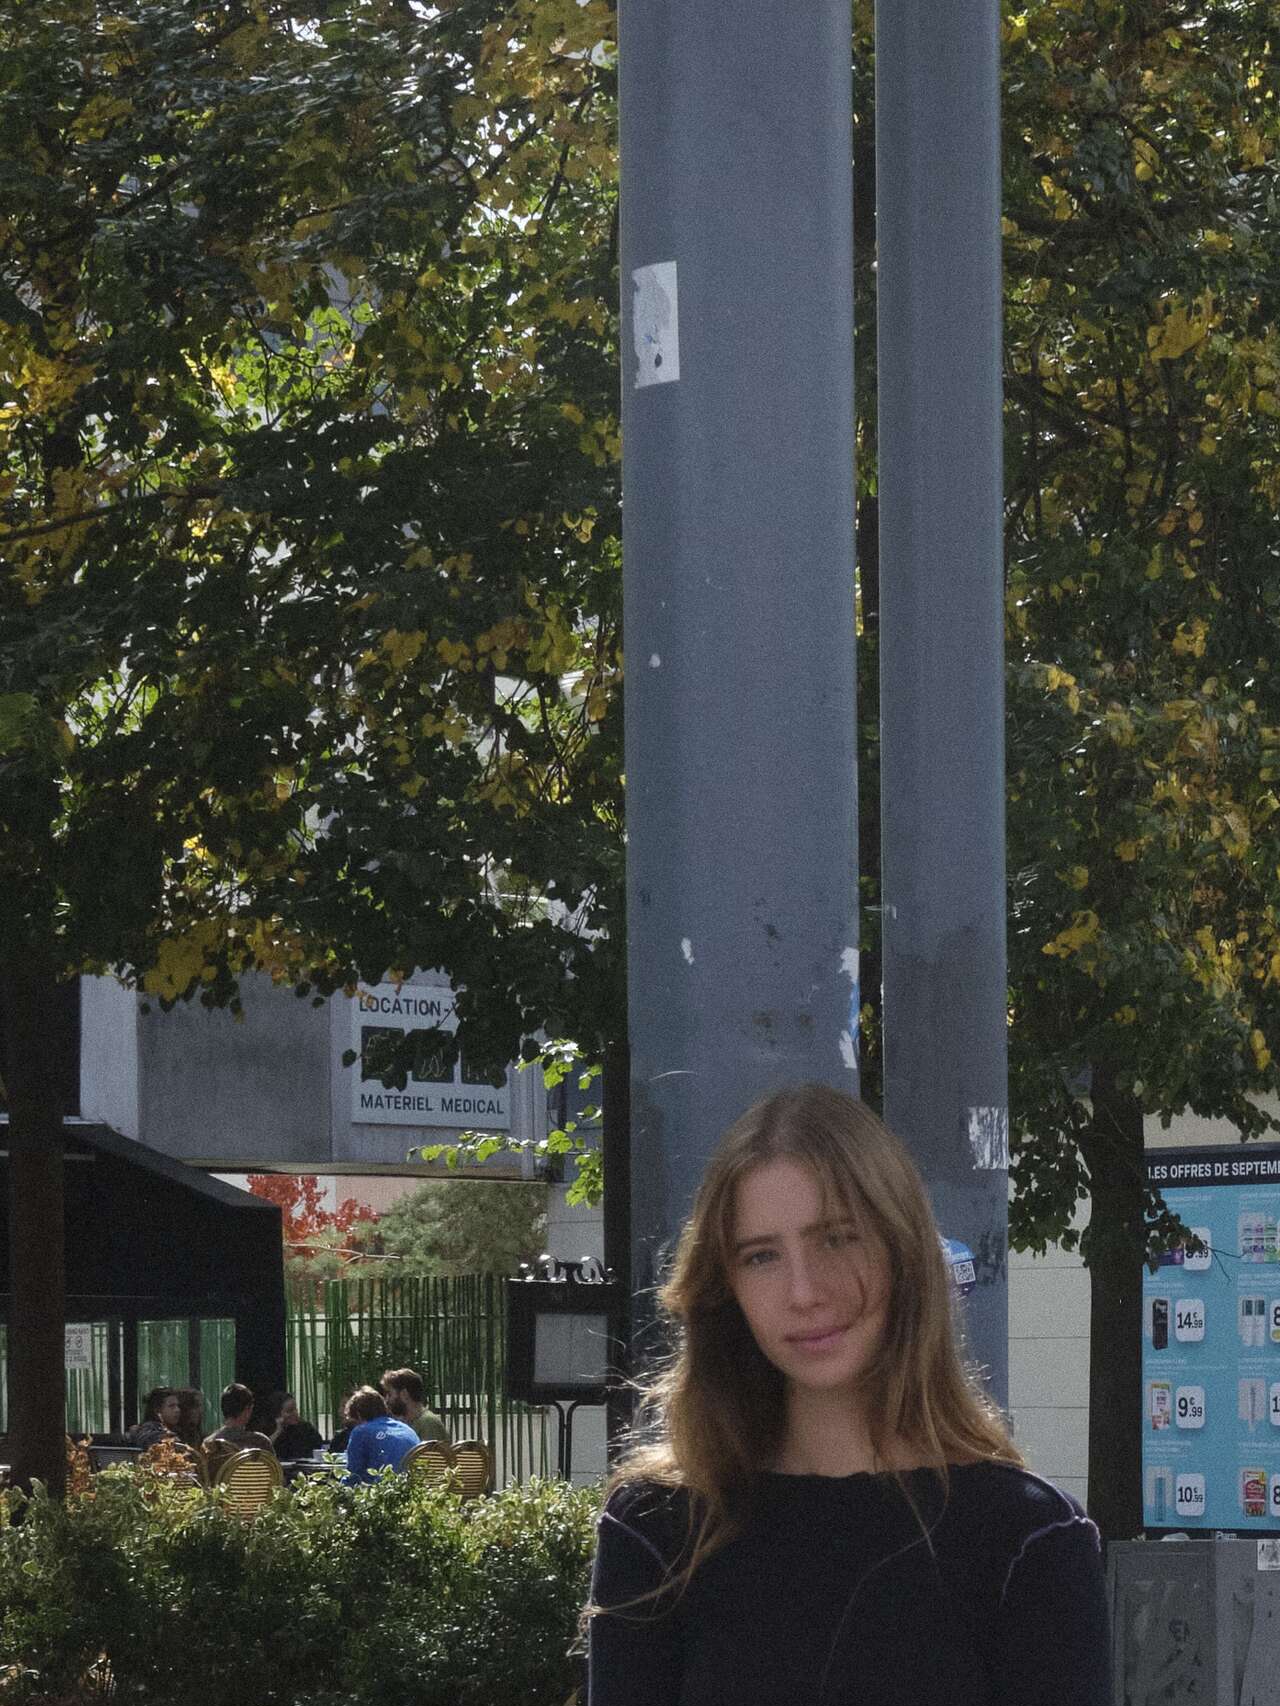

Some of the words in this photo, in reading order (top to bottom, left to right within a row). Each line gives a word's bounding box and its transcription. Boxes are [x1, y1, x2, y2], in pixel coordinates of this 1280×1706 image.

[361, 1094, 433, 1111] MATERIEL
[441, 1098, 504, 1114] MEDICAL
[1148, 1166, 1167, 1179] LES
[1170, 1163, 1211, 1178] OFFRES
[1214, 1162, 1228, 1176] DE
